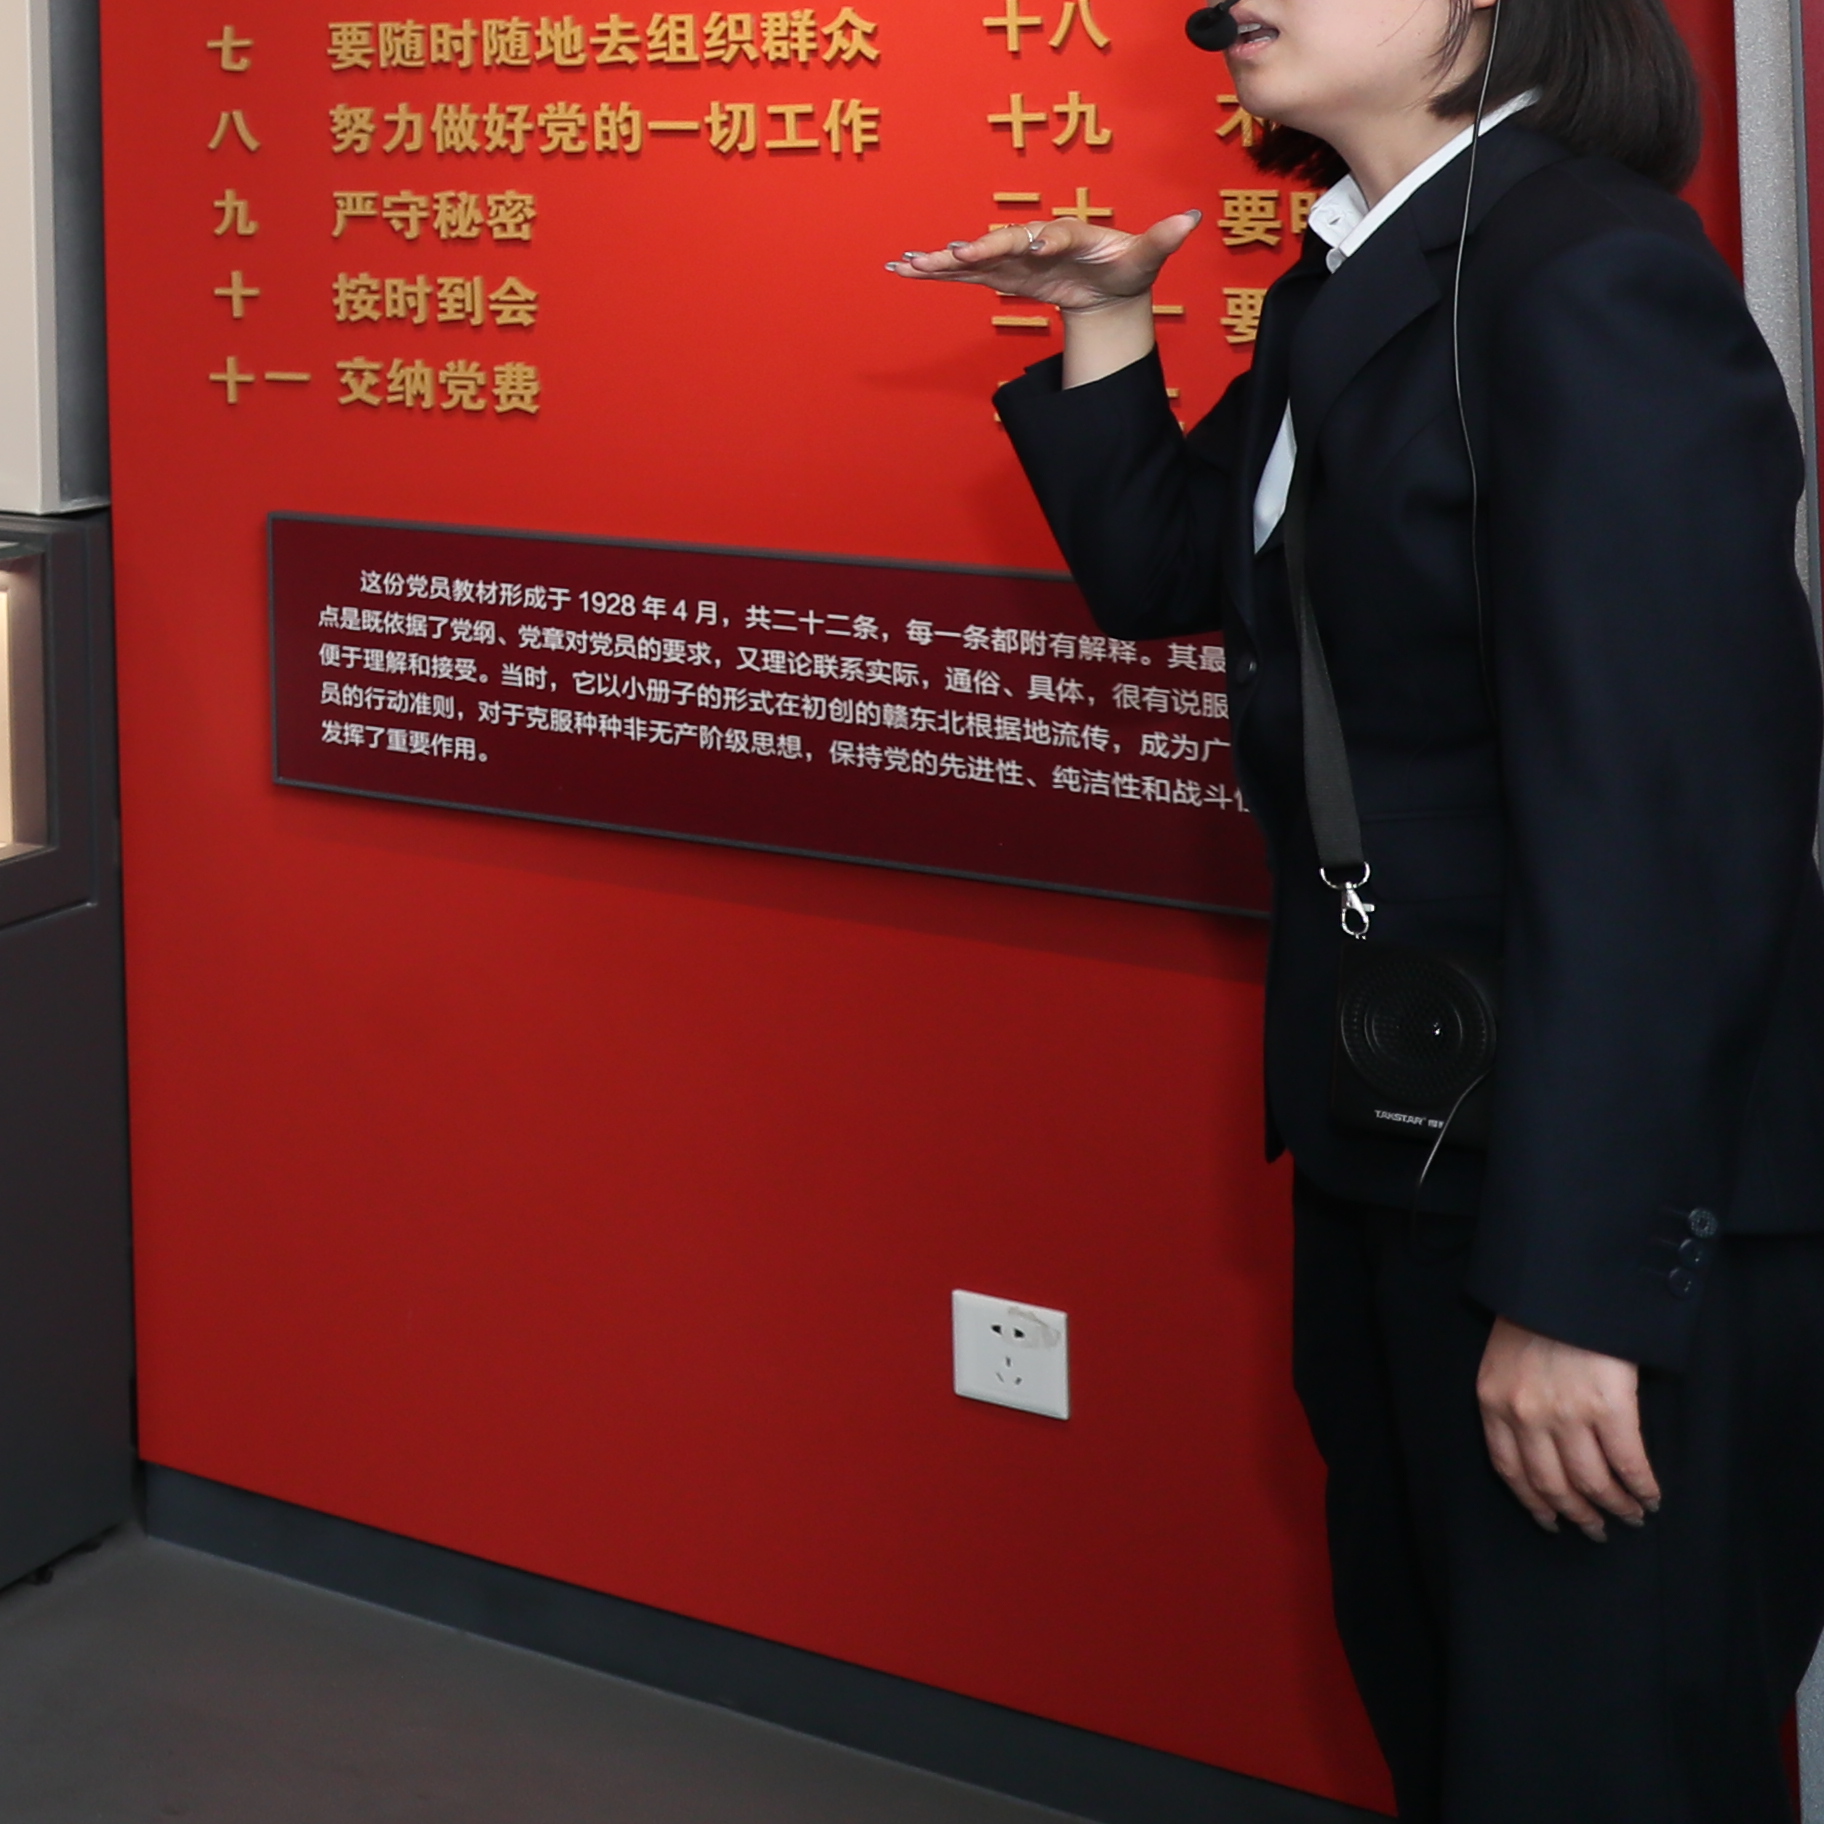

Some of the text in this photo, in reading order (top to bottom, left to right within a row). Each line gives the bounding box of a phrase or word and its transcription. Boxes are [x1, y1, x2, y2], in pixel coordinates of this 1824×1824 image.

[207, 7, 880, 70] 七 要随时随地去组织群众
[208, 98, 880, 153] 八 努力做好党的一切工作
[987, 91, 1111, 147] 十九
[214, 189, 537, 240] 九 严守秘密
[214, 271, 538, 326] 十 按时到会
[209, 356, 540, 413] 十一 交纳党费
[321, 719, 489, 763] 发挥了重要作用。
